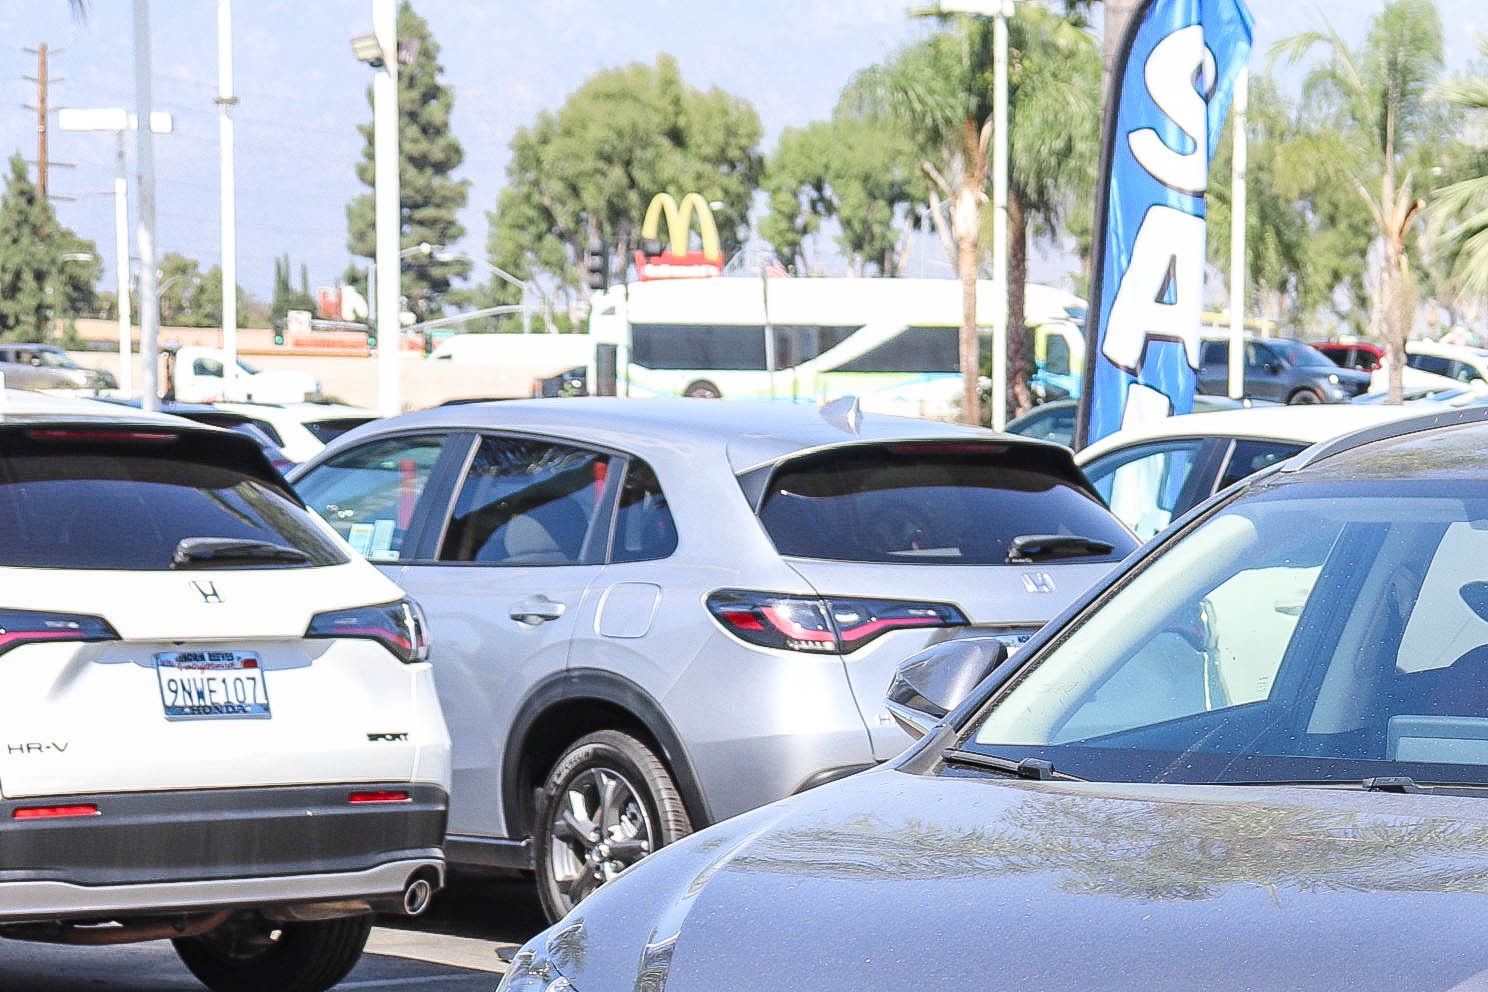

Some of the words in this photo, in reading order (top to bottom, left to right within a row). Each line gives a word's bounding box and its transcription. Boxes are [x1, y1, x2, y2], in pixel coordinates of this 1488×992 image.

[1101, 22, 1218, 432] SA
[167, 676, 257, 707] 9NWE107
[7, 741, 69, 755] HR-V
